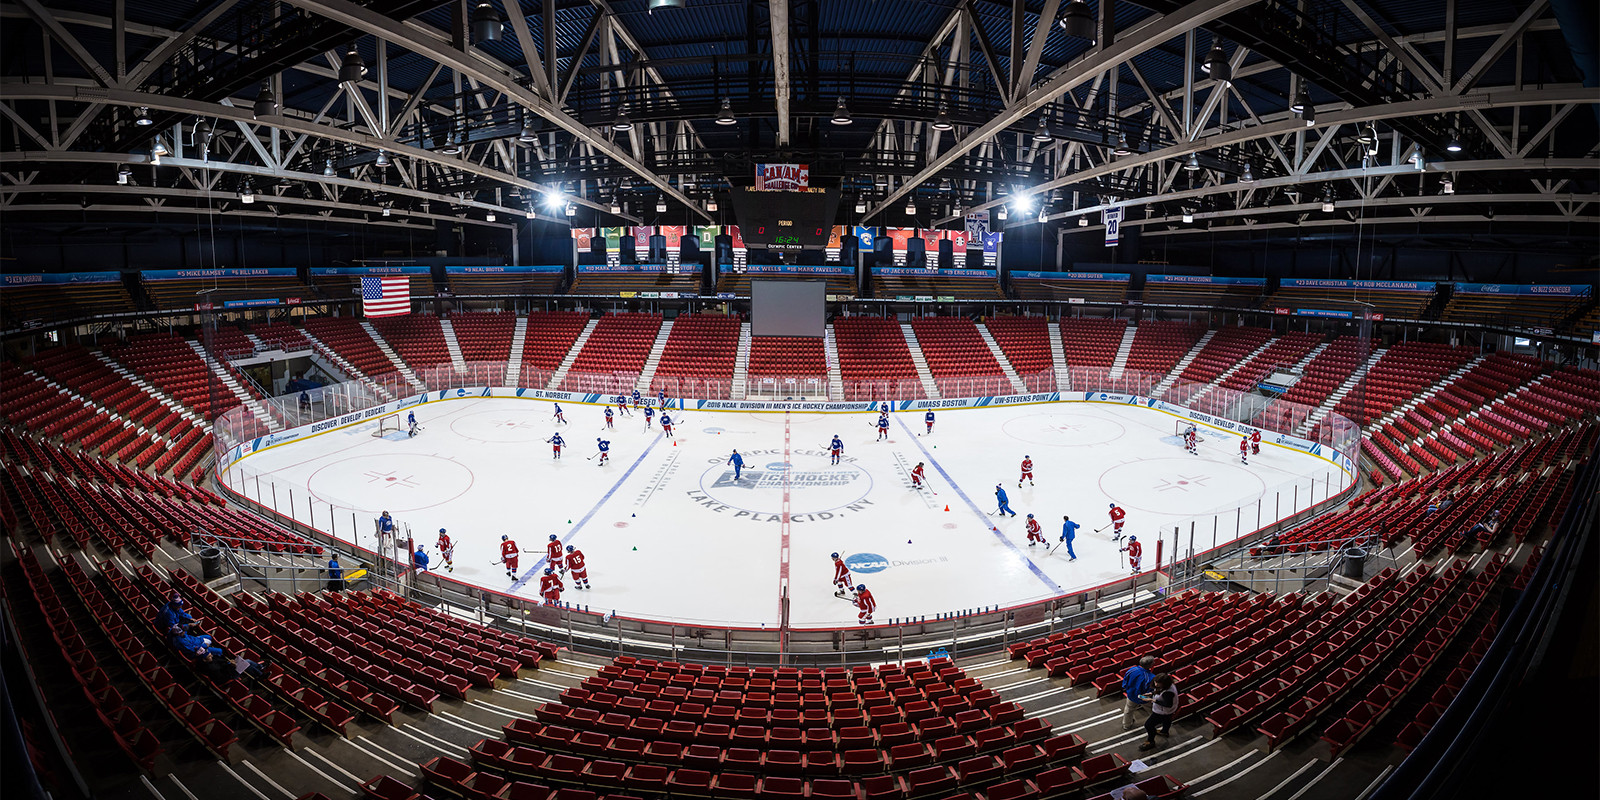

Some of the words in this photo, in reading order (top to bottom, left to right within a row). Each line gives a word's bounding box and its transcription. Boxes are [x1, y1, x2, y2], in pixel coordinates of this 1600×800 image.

[764, 165, 801, 184] CAN/AM
[1108, 219, 1117, 234] 20
[535, 390, 545, 398] ST.
[545, 391, 572, 400] NORBERT
[994, 395, 1032, 404] UW-STEVENS
[1032, 394, 1049, 402] POINT
[825, 403, 868, 411] CHAMPIONSHIP
[917, 401, 941, 409] UMASS
[942, 399, 968, 407] BOSTON
[311, 420, 337, 433] DISCOVER
[341, 412, 361, 424] DEVELOP
[365, 405, 386, 418] DEDICATE
[1189, 411, 1211, 423] DISCOVER
[1213, 417, 1235, 430] DEVELOP
[794, 473, 860, 481] HOCKEY
[686, 490, 730, 512] LAKE
[733, 510, 845, 523] PLACID,
[846, 498, 874, 512] NY
[507, 543, 513, 551] 2
[572, 555, 581, 564] 15
[892, 556, 936, 567] Division
[850, 561, 888, 569] NCAA
[548, 579, 554, 587] 7
